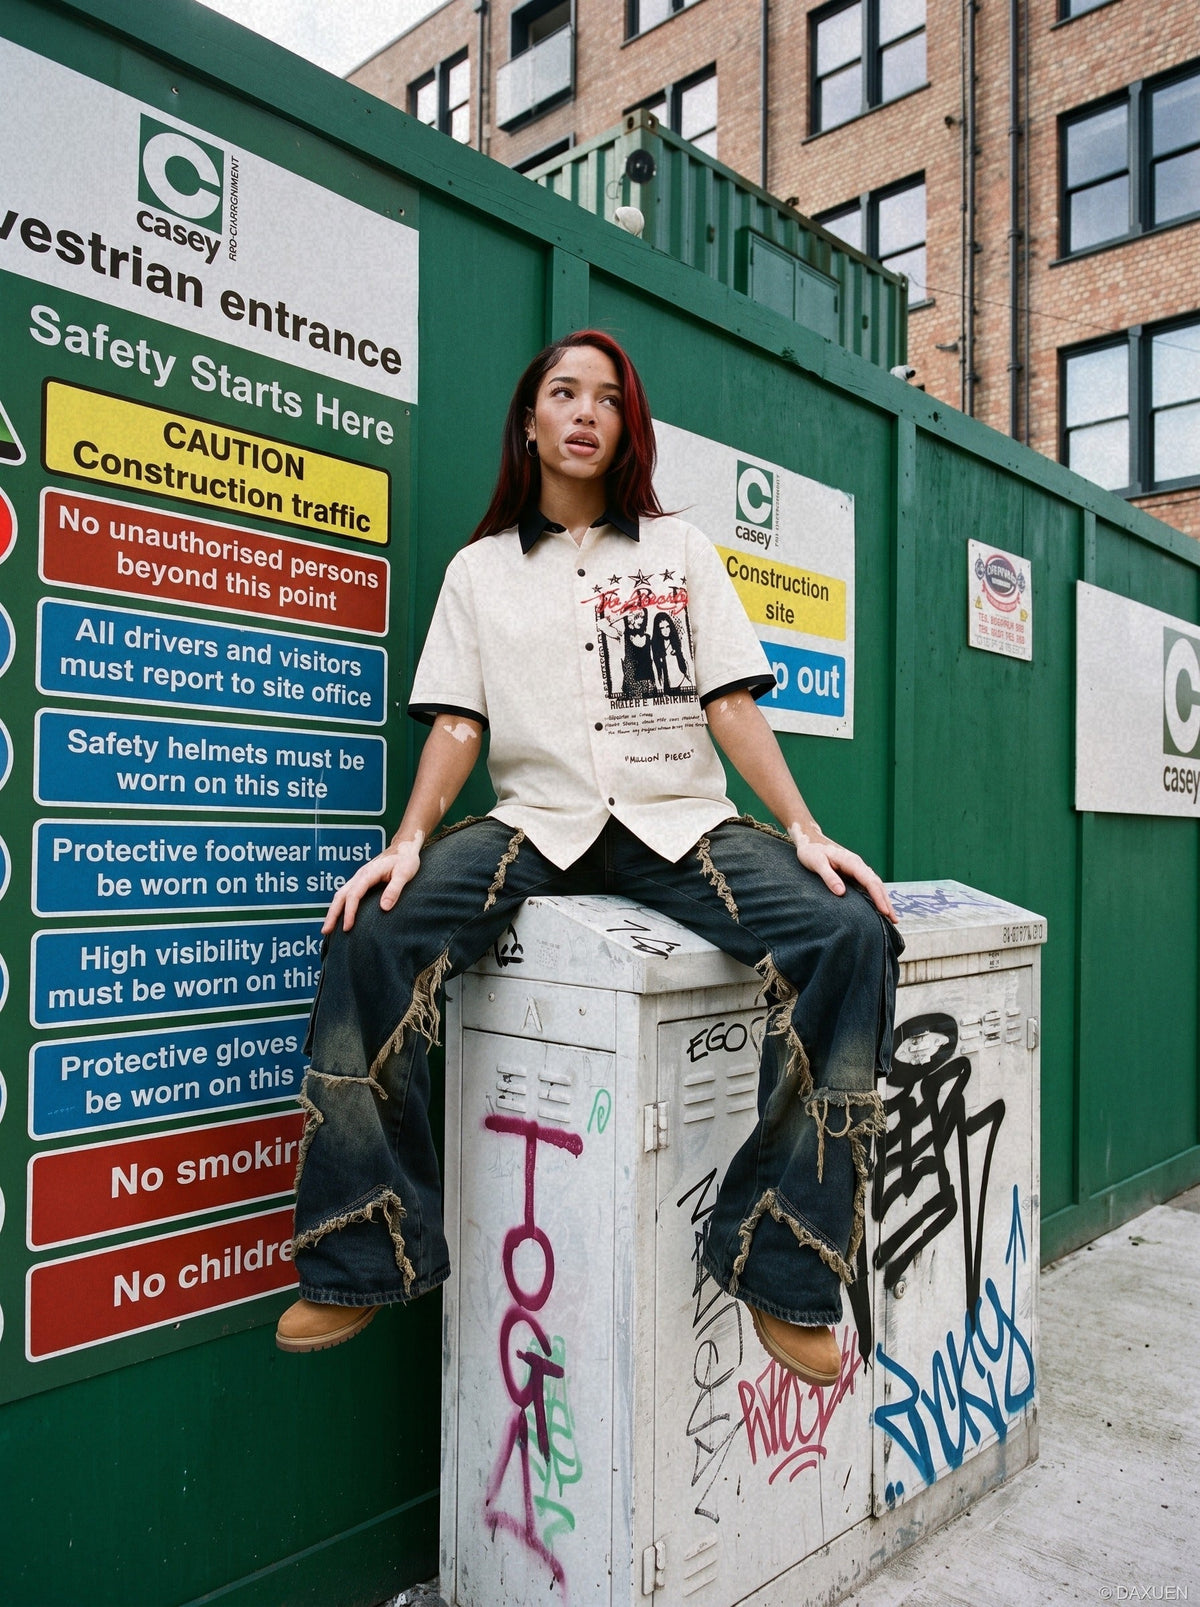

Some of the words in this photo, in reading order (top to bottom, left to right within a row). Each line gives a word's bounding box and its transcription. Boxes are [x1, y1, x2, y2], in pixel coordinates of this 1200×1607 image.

[137, 210, 222, 265] casey
[221, 291, 401, 374] entrance
[30, 305, 176, 387] Safety
[191, 355, 302, 417] Starts
[317, 393, 393, 445] Here
[163, 421, 304, 480] CAUTION
[73, 440, 283, 512] Construction
[292, 494, 370, 532] traffic
[60, 506, 99, 534] No
[109, 521, 283, 570] unauthorised
[291, 558, 378, 590] persons
[735, 524, 772, 550] casey
[118, 552, 217, 589] beyond
[226, 573, 270, 598] this
[280, 587, 336, 610] point
[727, 555, 829, 602] Construction
[765, 600, 795, 625] site
[76, 619, 114, 644] All
[125, 626, 217, 657] drivers
[227, 644, 271, 664] and
[280, 648, 361, 676] visitors
[61, 658, 133, 681] must
[144, 667, 223, 692] report
[232, 673, 255, 694] to
[263, 677, 304, 699] site
[312, 683, 371, 706] office
[797, 664, 840, 699] out
[68, 729, 158, 763] Safety
[169, 737, 267, 764] helmets
[277, 750, 331, 768] must
[340, 750, 364, 770] be
[117, 773, 185, 791] worn
[195, 777, 226, 793] on
[235, 774, 279, 796] this
[288, 777, 327, 798] site
[1163, 766, 1200, 805] casey
[54, 838, 197, 862] Protective
[205, 840, 310, 861] footwear
[318, 842, 372, 862] must
[98, 874, 131, 896] be
[141, 878, 207, 895] worn
[217, 878, 246, 893] on
[255, 872, 298, 892] this
[306, 871, 346, 892] site
[82, 945, 145, 974] High
[156, 939, 263, 965] visibility
[49, 982, 122, 1008] must
[133, 979, 165, 1001] be
[174, 977, 237, 997] worn
[247, 975, 275, 991] on
[62, 1045, 207, 1080] Protective
[217, 1036, 297, 1066] gloves
[86, 1091, 121, 1113] be
[131, 1082, 199, 1106] worn
[209, 1076, 240, 1095] on
[249, 1065, 293, 1089] this
[112, 1164, 163, 1198] No
[114, 1271, 165, 1306] No
